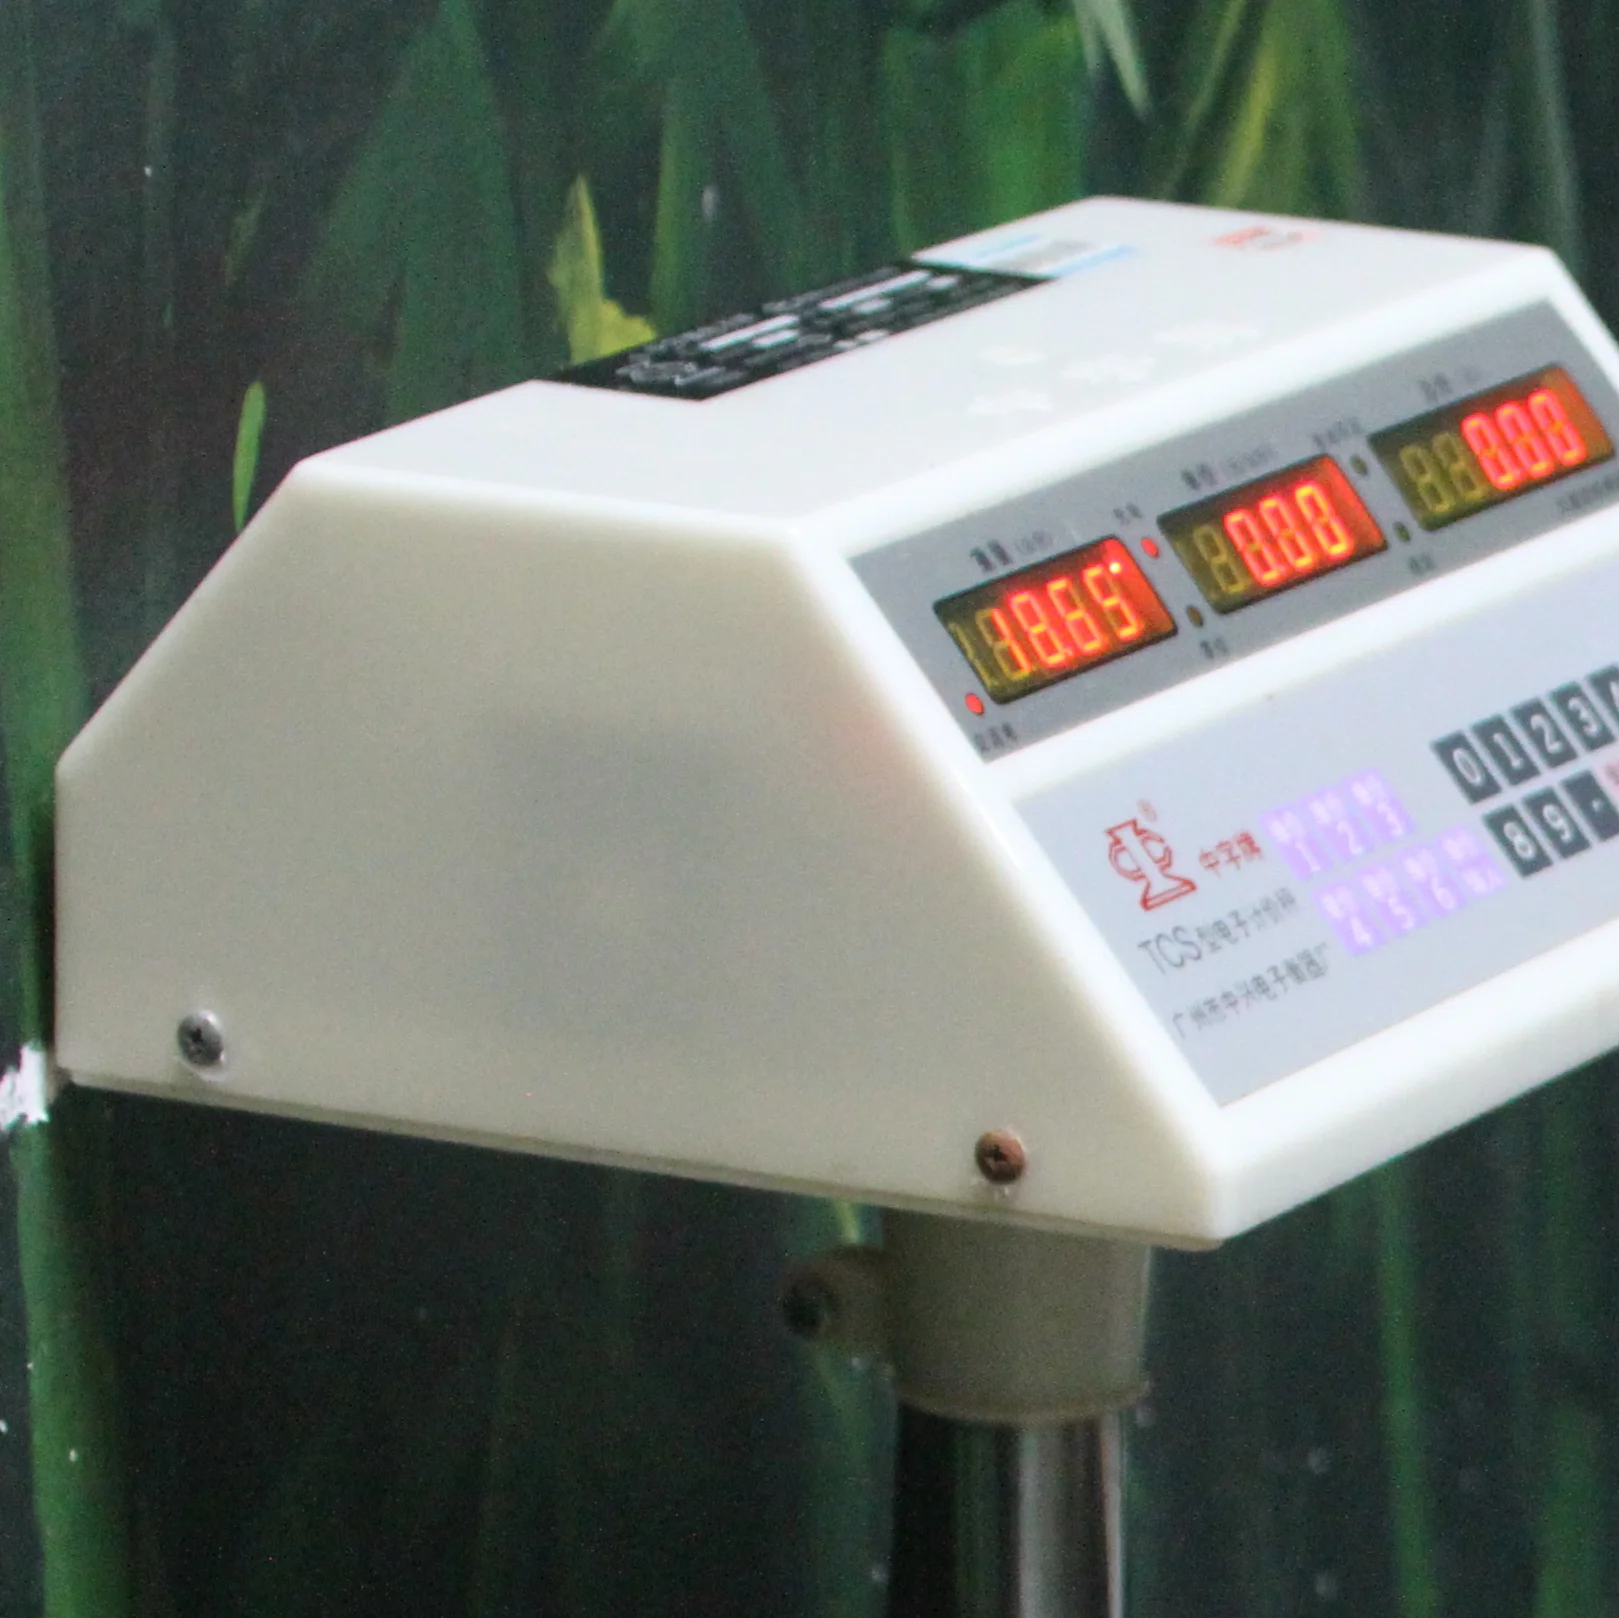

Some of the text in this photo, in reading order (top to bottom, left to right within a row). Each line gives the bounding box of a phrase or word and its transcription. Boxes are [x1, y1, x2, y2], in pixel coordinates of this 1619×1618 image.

[1452, 747, 1483, 787] 0
[1492, 732, 1523, 769] 1
[1530, 713, 1561, 754] 2
[1567, 696, 1598, 737] 3
[1335, 819, 1364, 854] 2
[1502, 820, 1534, 860] 8
[1542, 803, 1573, 843] 9
[1387, 896, 1416, 930] 5
[1429, 874, 1456, 910] 6
